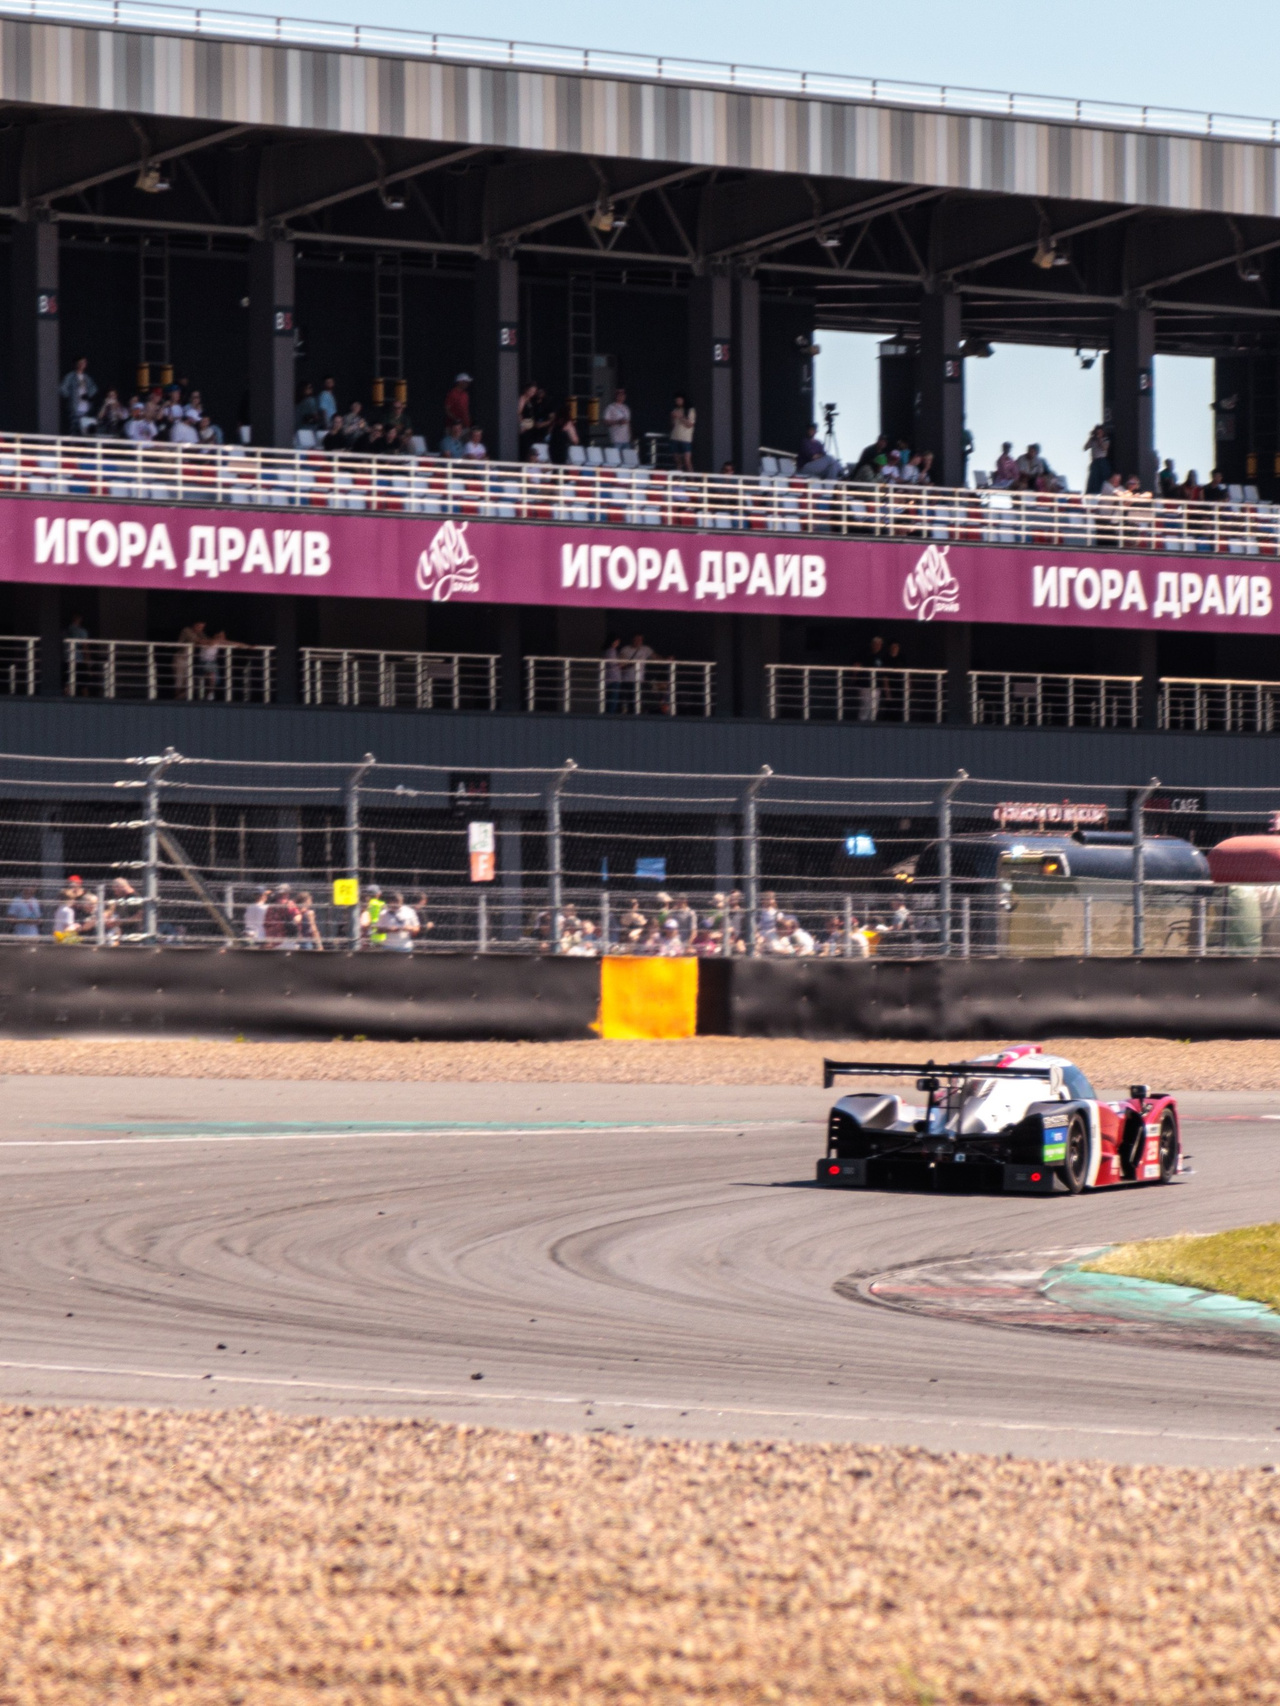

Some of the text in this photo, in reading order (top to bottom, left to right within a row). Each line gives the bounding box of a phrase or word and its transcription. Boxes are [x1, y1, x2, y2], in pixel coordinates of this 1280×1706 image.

[34, 517, 332, 578] ИГОРА ДРАЙВ
[561, 543, 827, 600] ИГОРА ДРАЙВ
[1033, 565, 1273, 619] ИГОРА ДРАЙВ
